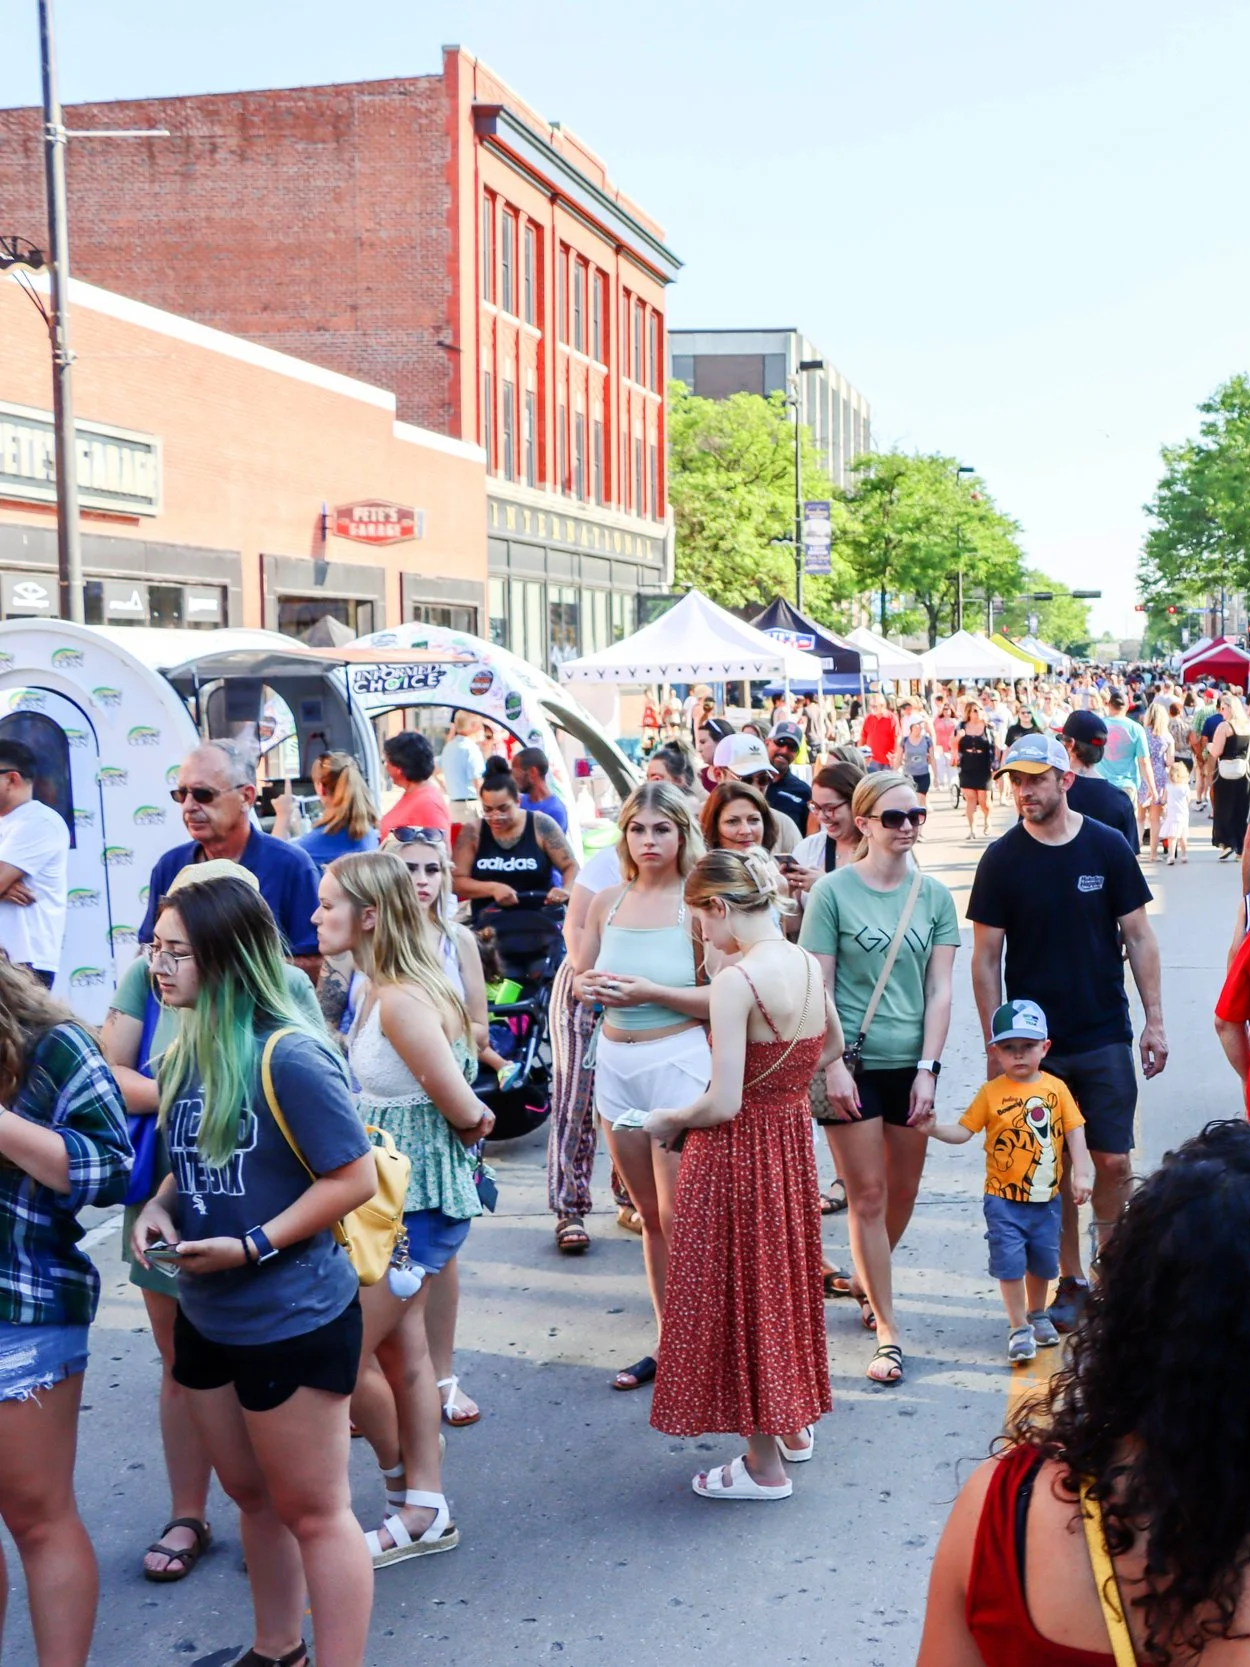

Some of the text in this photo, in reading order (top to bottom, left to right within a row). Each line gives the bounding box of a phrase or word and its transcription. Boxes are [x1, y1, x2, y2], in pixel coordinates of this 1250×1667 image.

[352, 506, 398, 522] PETE'S
[349, 523, 400, 536] GARAGE
[491, 502, 653, 559] INTERNATIONAL
[353, 674, 441, 694] CHOICE
[477, 857, 538, 872] adidas
